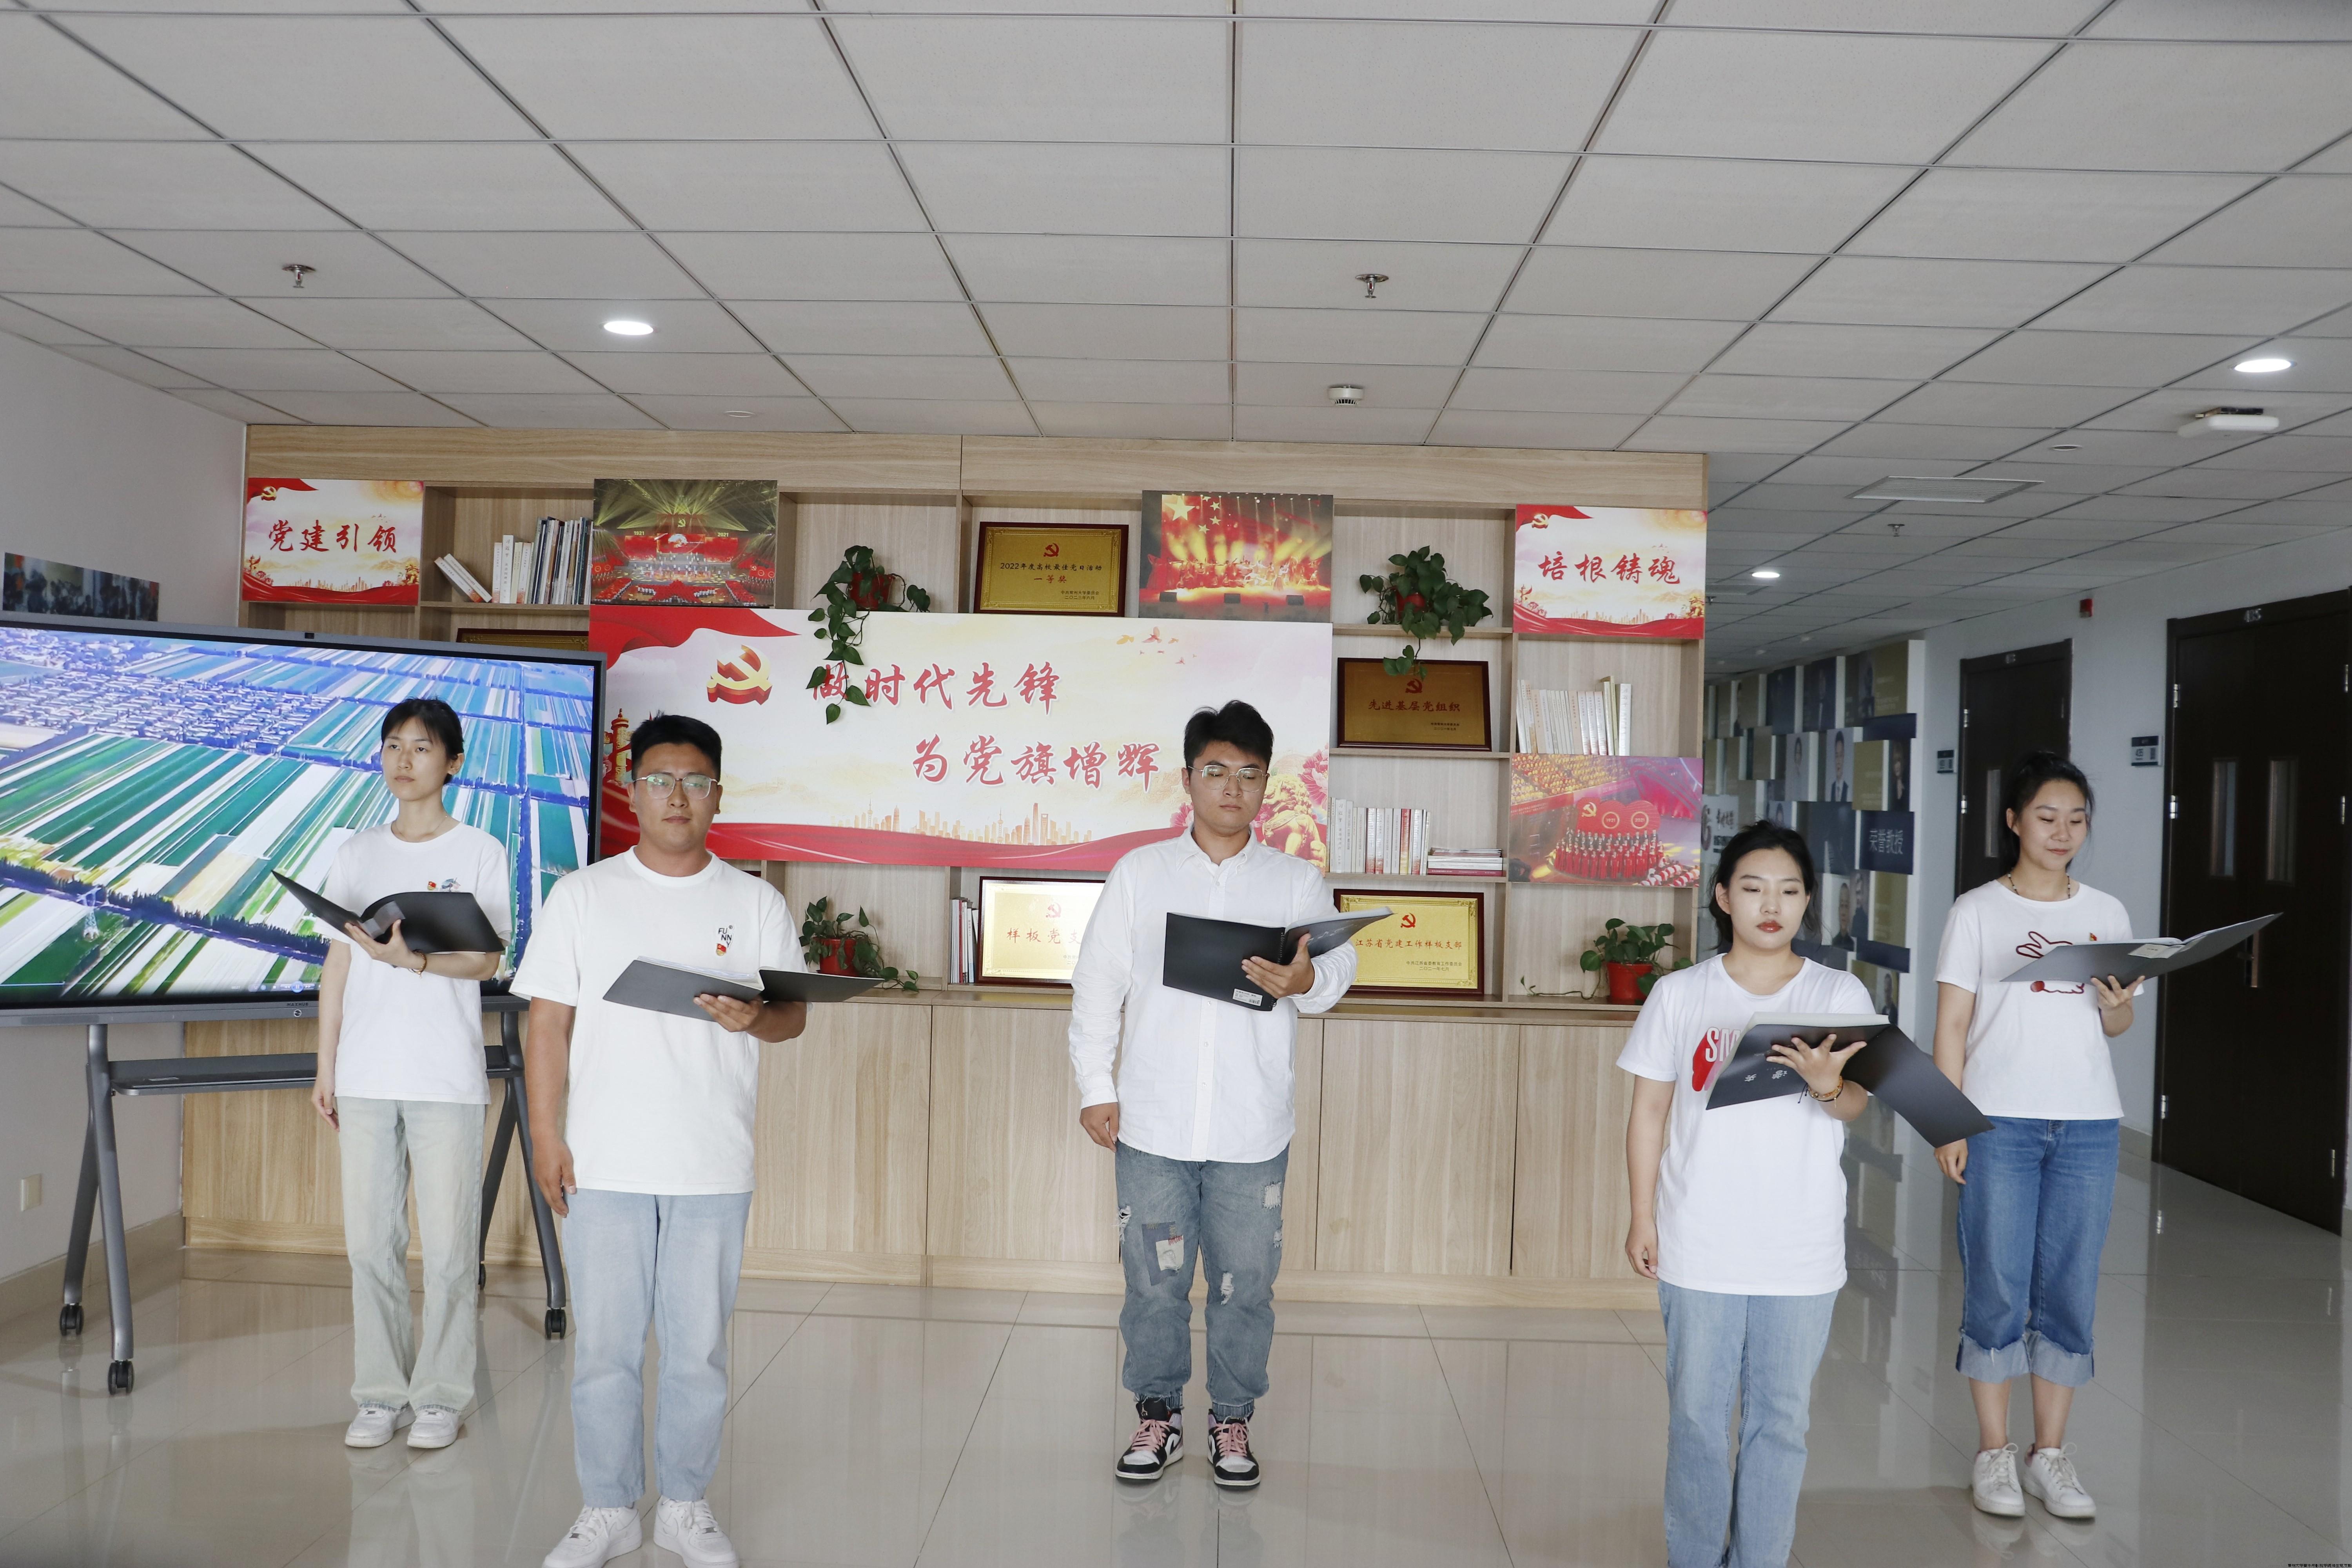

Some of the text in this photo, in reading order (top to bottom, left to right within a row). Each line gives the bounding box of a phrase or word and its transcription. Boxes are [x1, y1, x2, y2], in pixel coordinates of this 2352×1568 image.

[269, 519, 397, 553] 党建引领
[1000, 562, 1102, 572] 2022年度高校最佳党日活动
[1034, 575, 1067, 584] 一等奖
[1538, 551, 1681, 584] 培根铸魂
[812, 662, 1061, 716] 做时代先锋
[1368, 699, 1461, 712] 先进基层党组织
[913, 733, 1162, 794] 为党旗增辉
[1868, 828, 1904, 855] 荣誉教授
[1355, 938, 1463, 950] 江苏省党建工作样板支部
